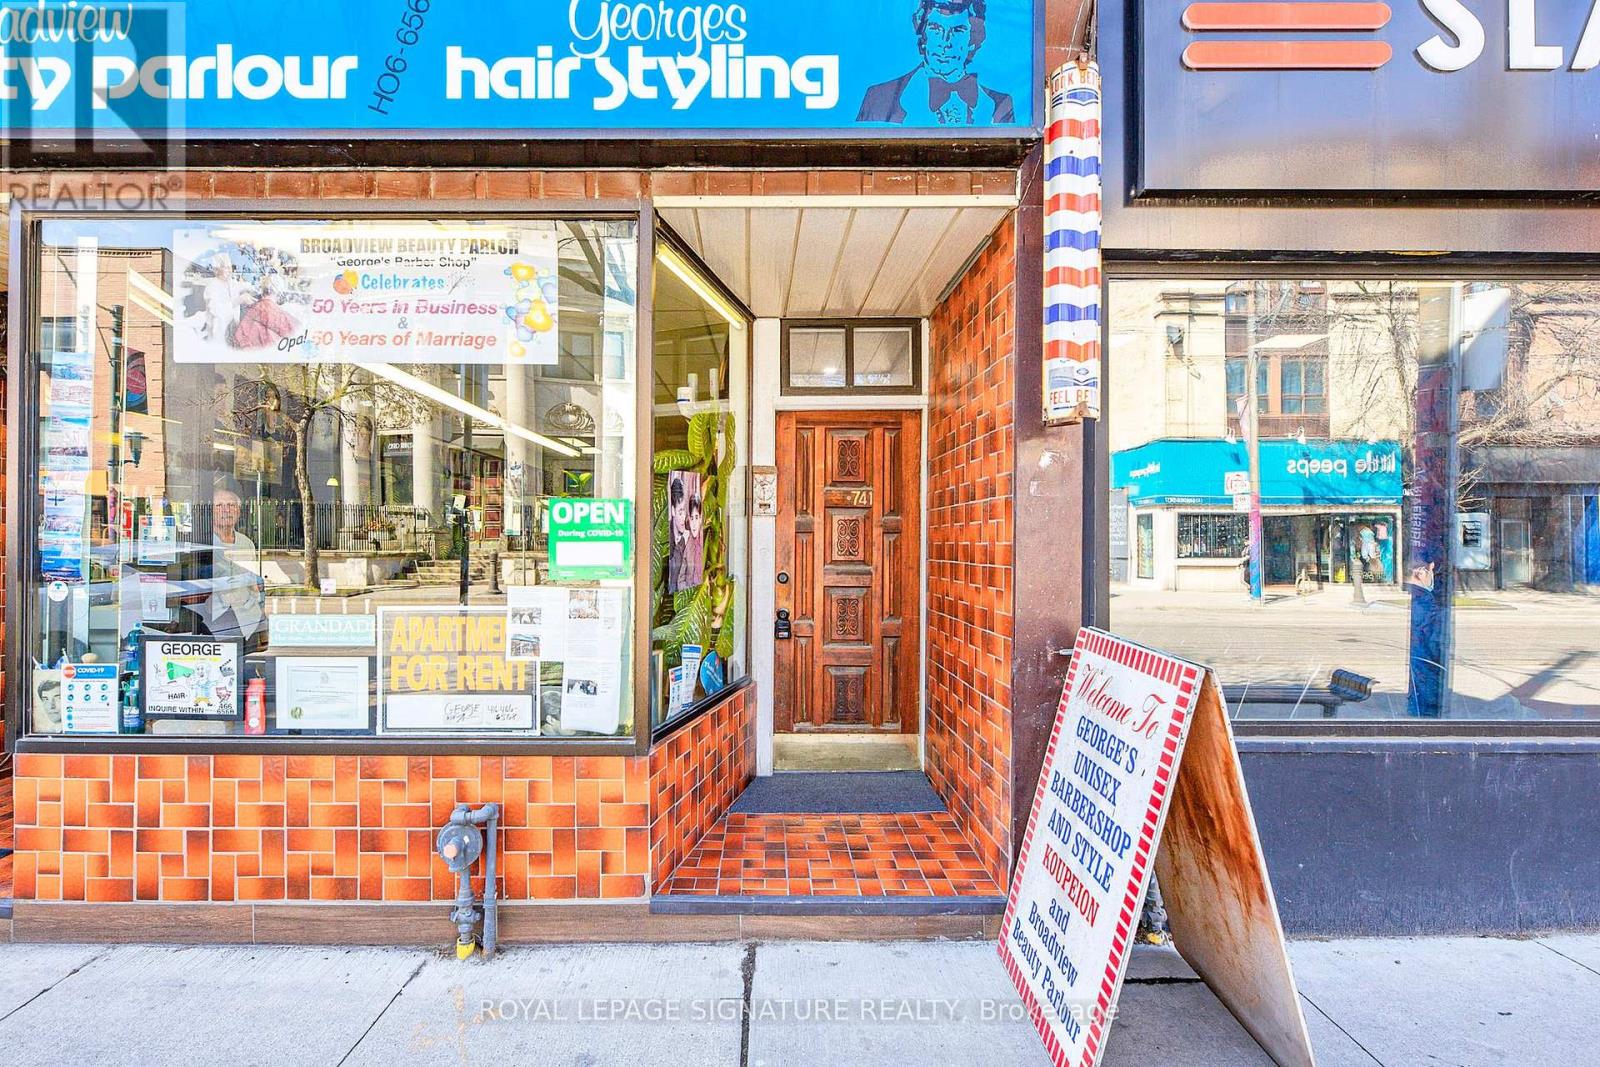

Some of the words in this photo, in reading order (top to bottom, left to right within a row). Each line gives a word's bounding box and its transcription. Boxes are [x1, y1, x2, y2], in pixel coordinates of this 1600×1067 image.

[568, 0, 748, 59] Georges
[300, 238, 393, 254] BROADVIEW
[397, 238, 454, 254] BEAUTY
[459, 238, 520, 255] PARLOR
[361, 274, 445, 290] Celebrates
[312, 299, 335, 314] 50
[341, 299, 388, 314] Years
[392, 299, 409, 314] in
[415, 299, 498, 315] Business
[397, 316, 409, 329] &
[277, 328, 308, 352] Opa!
[339, 330, 387, 346] Years
[392, 330, 412, 346] of
[416, 331, 497, 350] Marriage
[552, 501, 625, 524] OPEN
[851, 490, 873, 506] 741
[161, 643, 222, 656] GEORGE
[389, 655, 449, 691] FOR
[456, 655, 526, 691] RENT
[148, 705, 177, 713] INQUIRE
[1076, 663, 1132, 725] Welcome
[1131, 693, 1167, 740] To
[1074, 750, 1121, 807] UNISEX
[1050, 770, 1132, 860] BARBERSHOP
[1047, 808, 1072, 845] AND
[1071, 831, 1115, 894] STYLE
[1042, 843, 1100, 928] KOUPEION
[1048, 898, 1071, 936] and
[1028, 900, 1079, 988] Broadview
[1012, 917, 1042, 980] Beauty
[1041, 965, 1081, 1045] Parlour
